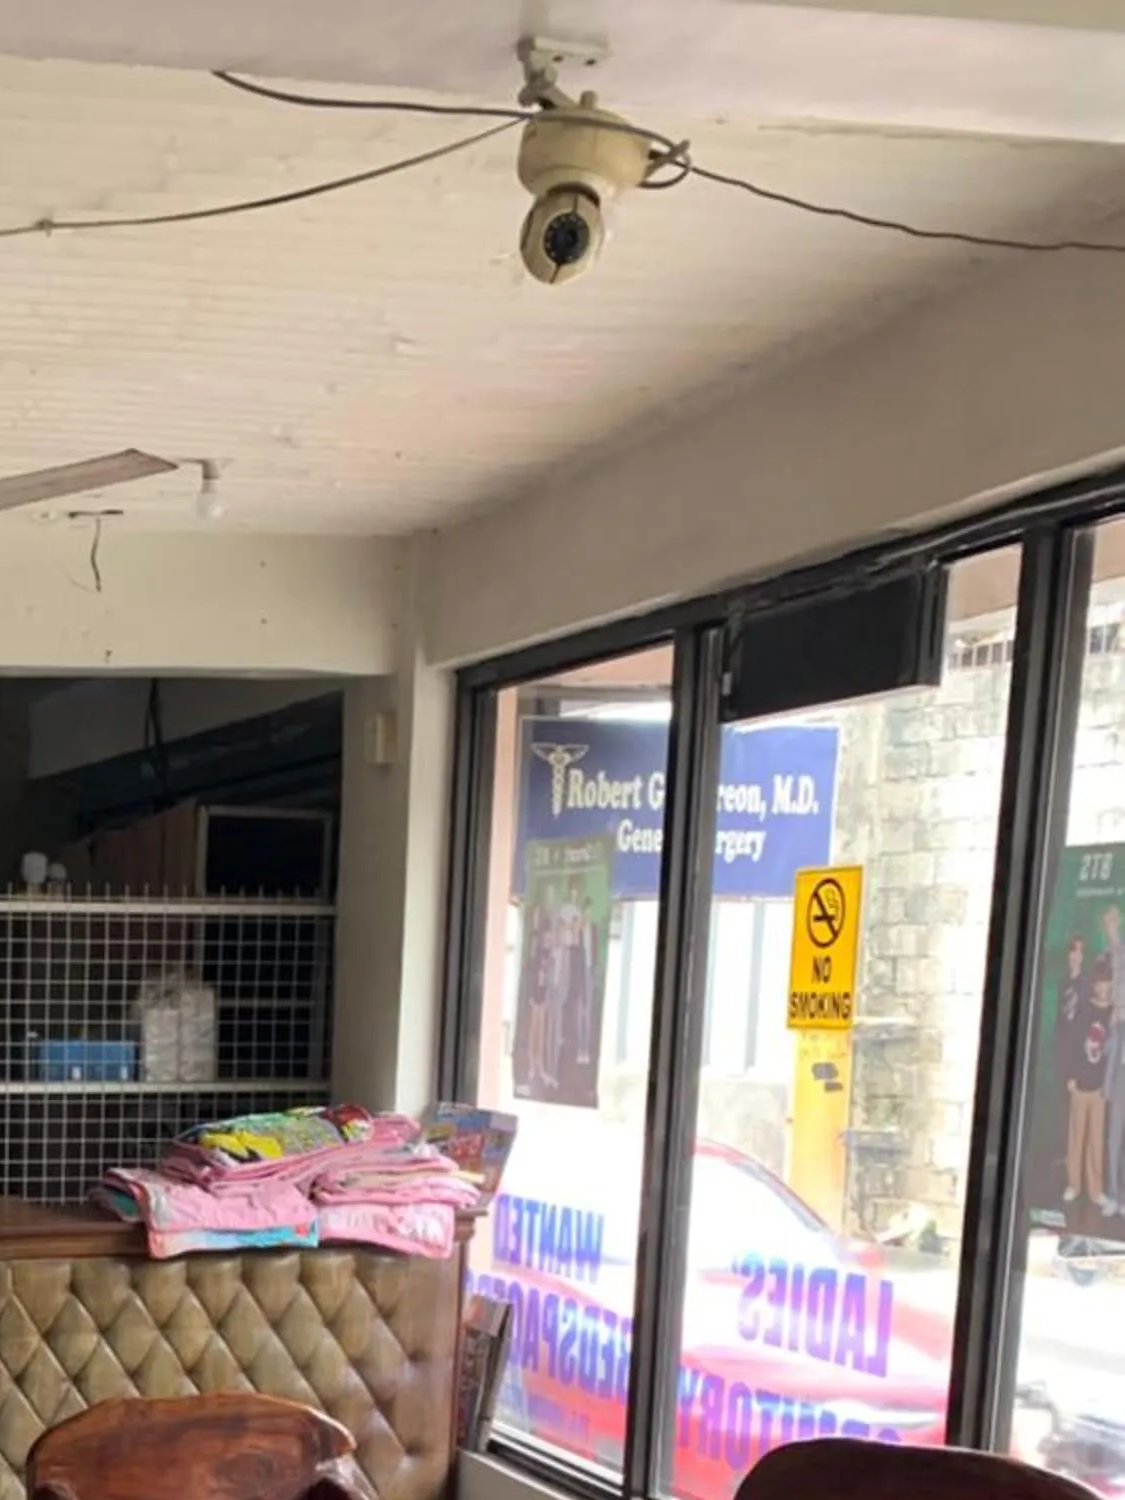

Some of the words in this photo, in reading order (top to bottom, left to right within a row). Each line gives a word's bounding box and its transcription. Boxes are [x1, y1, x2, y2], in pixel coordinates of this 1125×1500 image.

[567, 768, 642, 810] Robert
[717, 784, 767, 822] reon,
[773, 774, 820, 815] M.D.
[617, 818, 664, 852] Gene
[716, 828, 768, 864] rgery
[811, 955, 832, 984] NO
[789, 992, 851, 1020] SMOKING
